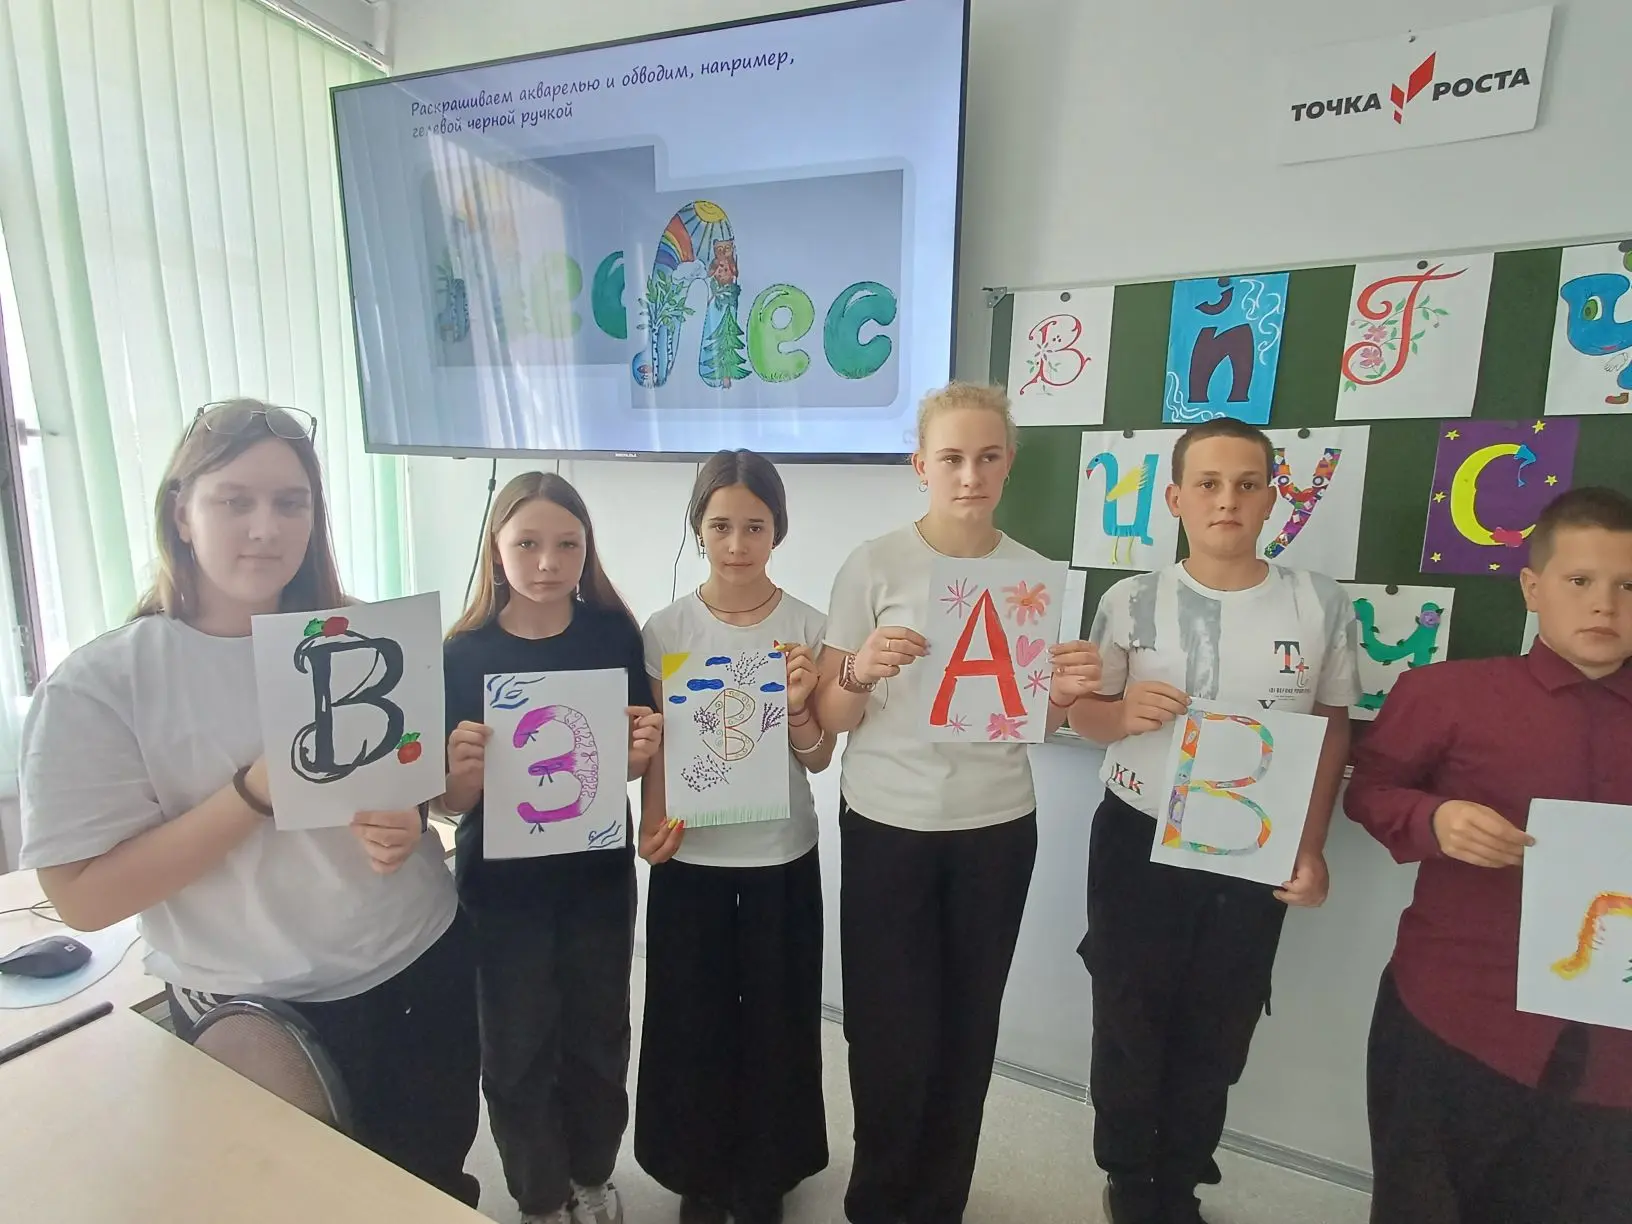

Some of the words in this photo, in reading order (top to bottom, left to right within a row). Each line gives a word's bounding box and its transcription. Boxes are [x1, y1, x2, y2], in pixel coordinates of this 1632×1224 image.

[411, 89, 513, 116] Раскрашиваем
[519, 76, 600, 101] акварелью
[606, 77, 615, 88] и
[622, 64, 694, 87] обводим,
[700, 51, 794, 77] например,
[1291, 92, 1382, 122] ТОЧКА
[1432, 67, 1530, 101] РОСТА
[467, 111, 515, 133] черной
[521, 101, 573, 128] ручкой
